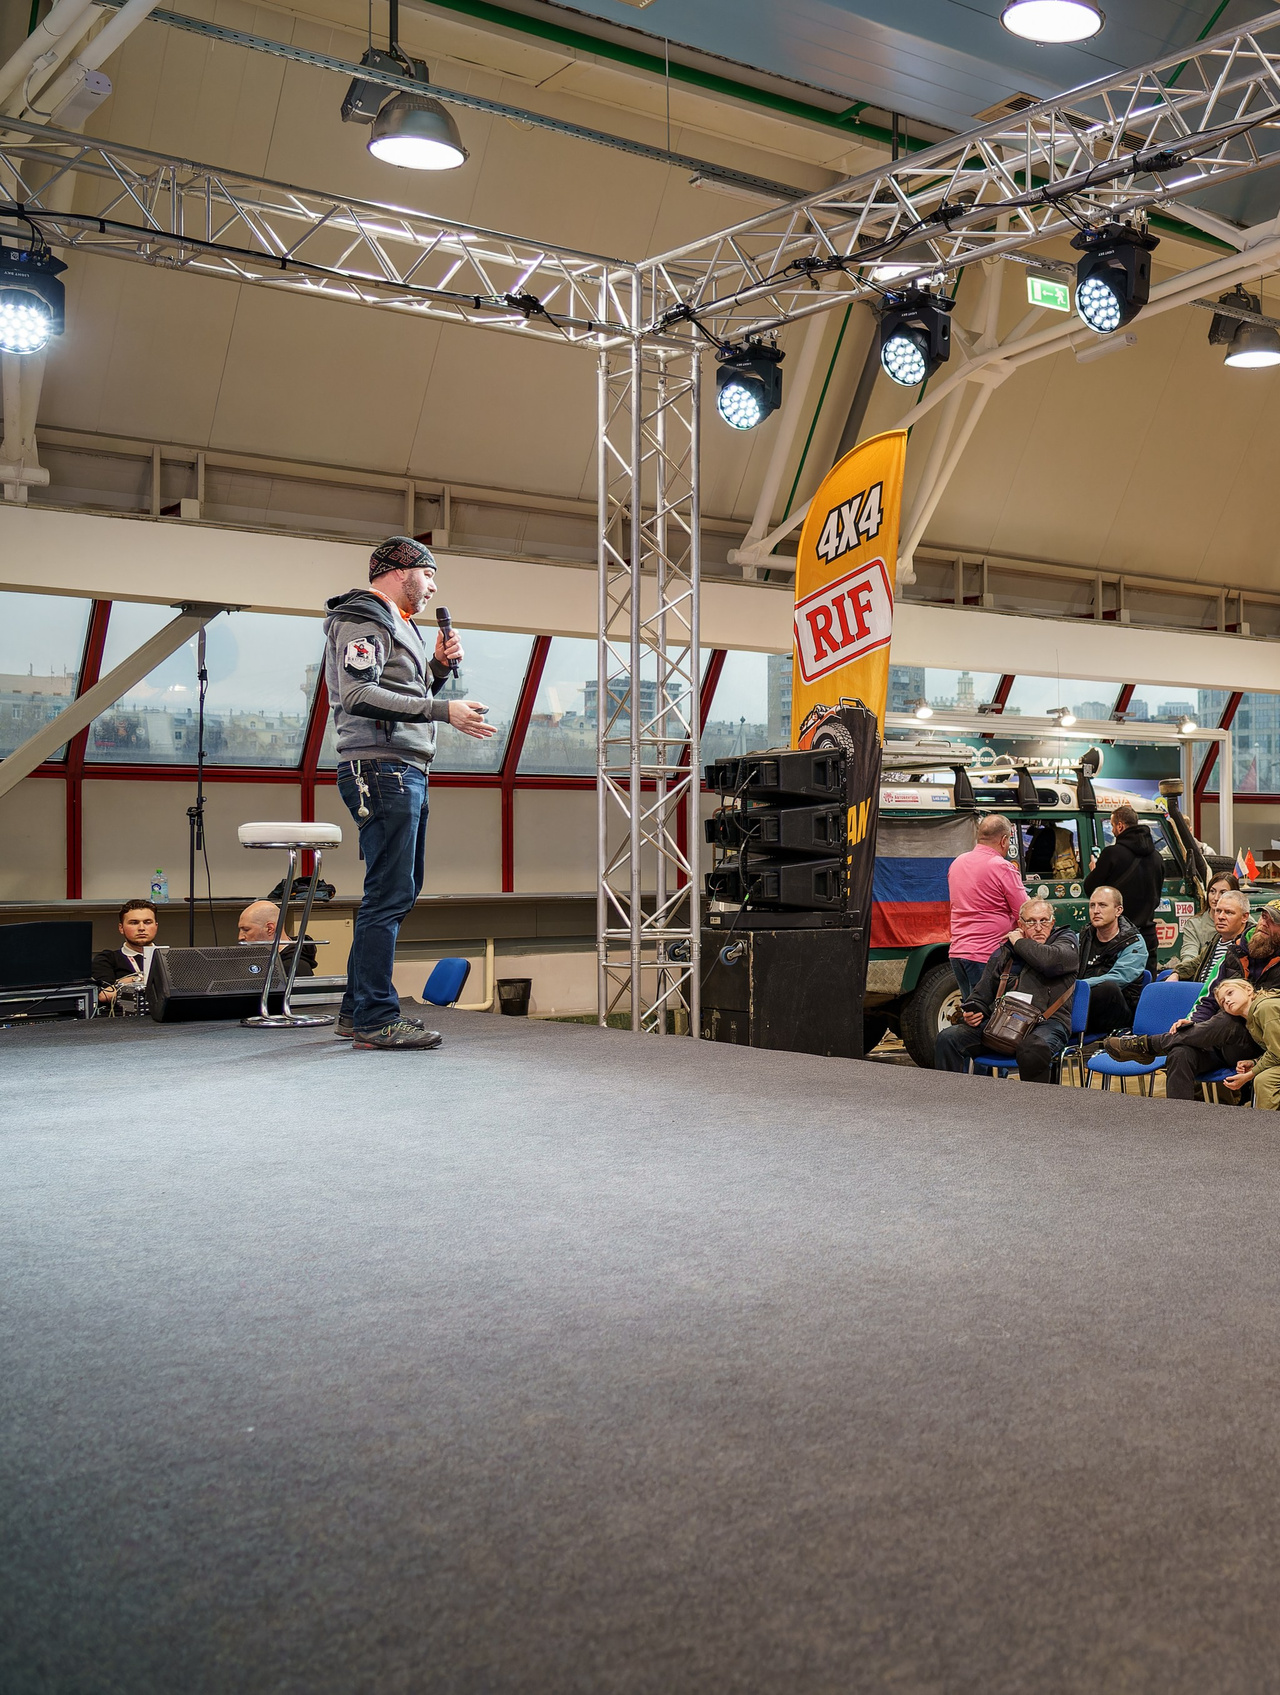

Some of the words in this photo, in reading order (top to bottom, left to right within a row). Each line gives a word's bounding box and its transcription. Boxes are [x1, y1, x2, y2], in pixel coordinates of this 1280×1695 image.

[806, 580, 873, 663] RIF
[1096, 796, 1131, 804] DELTA
[1176, 904, 1194, 914] РИФ
